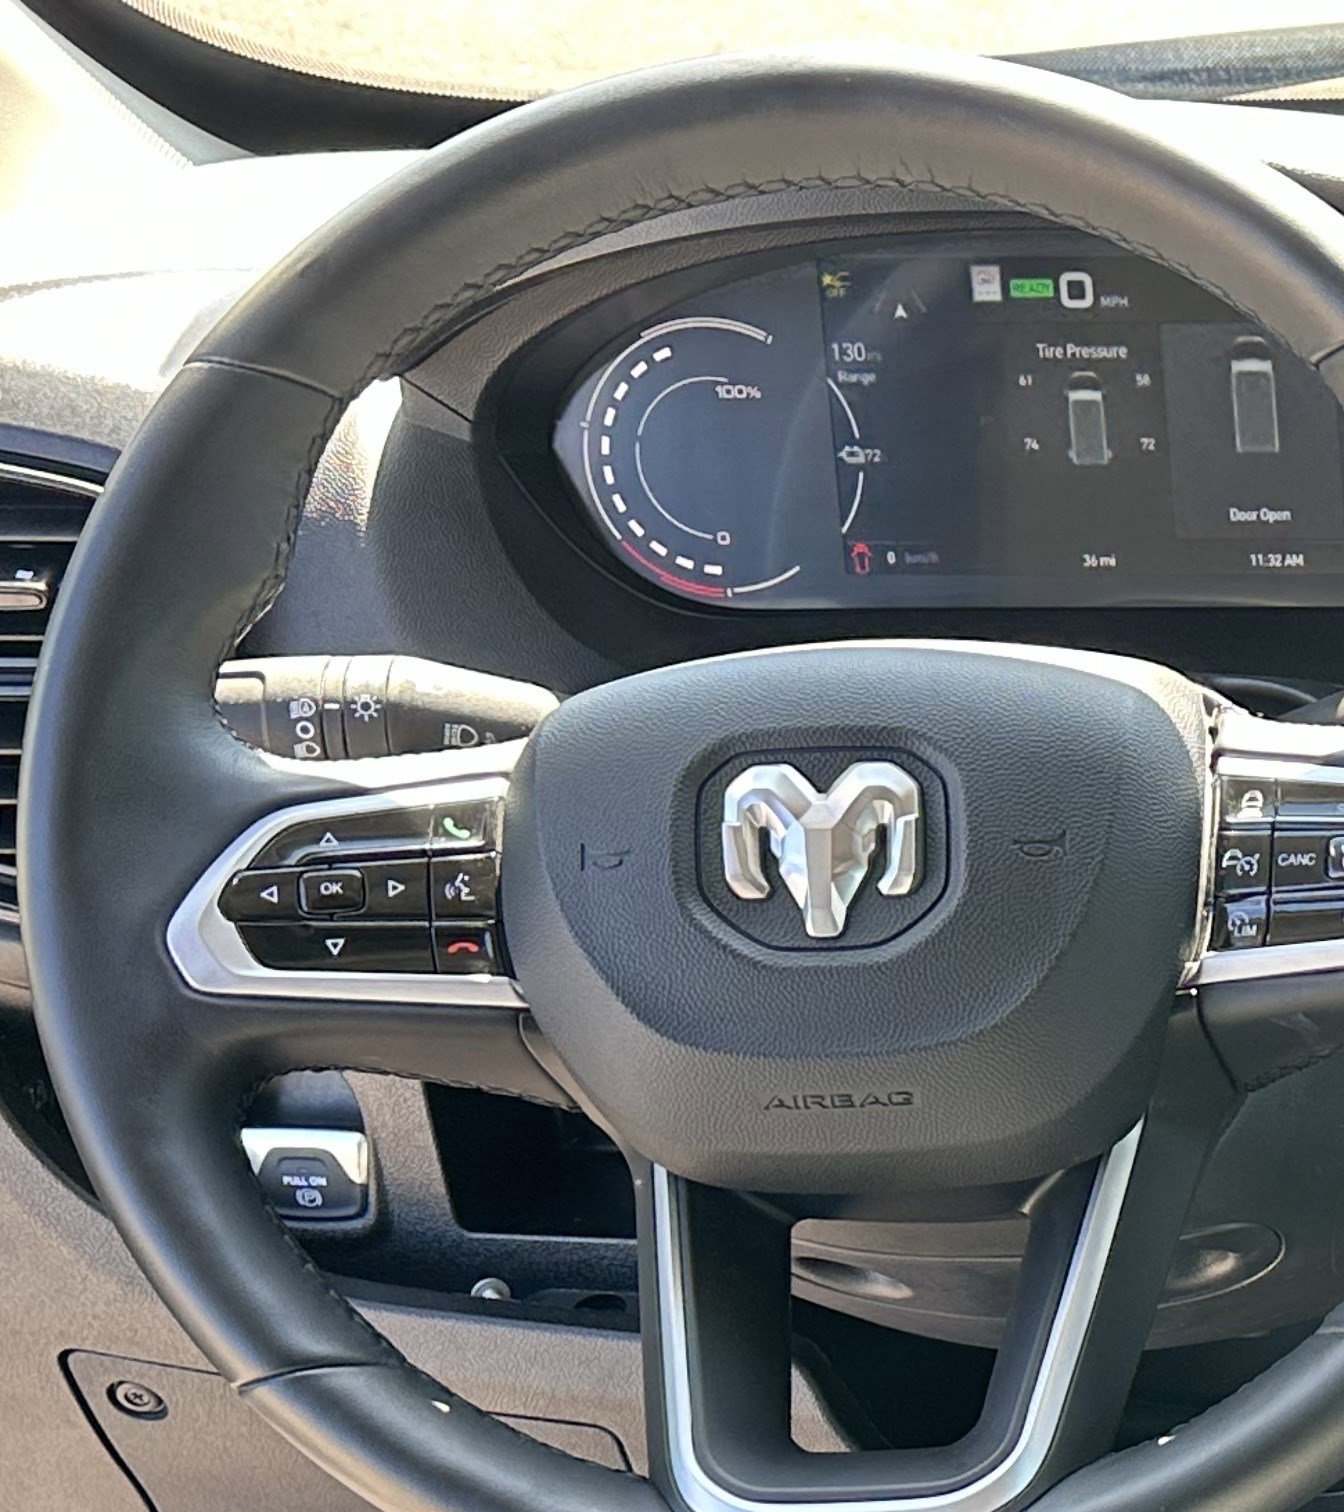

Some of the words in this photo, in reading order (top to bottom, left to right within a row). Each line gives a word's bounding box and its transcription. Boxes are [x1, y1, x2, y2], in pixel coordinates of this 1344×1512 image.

[1059, 271, 1094, 308] 0
[1100, 295, 1129, 308] MPH
[831, 342, 867, 363] 130
[1035, 343, 1065, 359] Tire
[1066, 343, 1129, 359] Pressure
[714, 384, 762, 399] 100%
[1139, 437, 1156, 451] 72
[864, 448, 882, 463] 72
[1229, 507, 1258, 521] Door
[1260, 507, 1292, 523] Open
[1250, 553, 1283, 567] 11:32
[1284, 553, 1305, 567] AM
[1277, 853, 1318, 867] CANC
[319, 880, 344, 897] OK
[1234, 922, 1258, 937] LIM
[763, 1090, 915, 1112] AIRBAG
